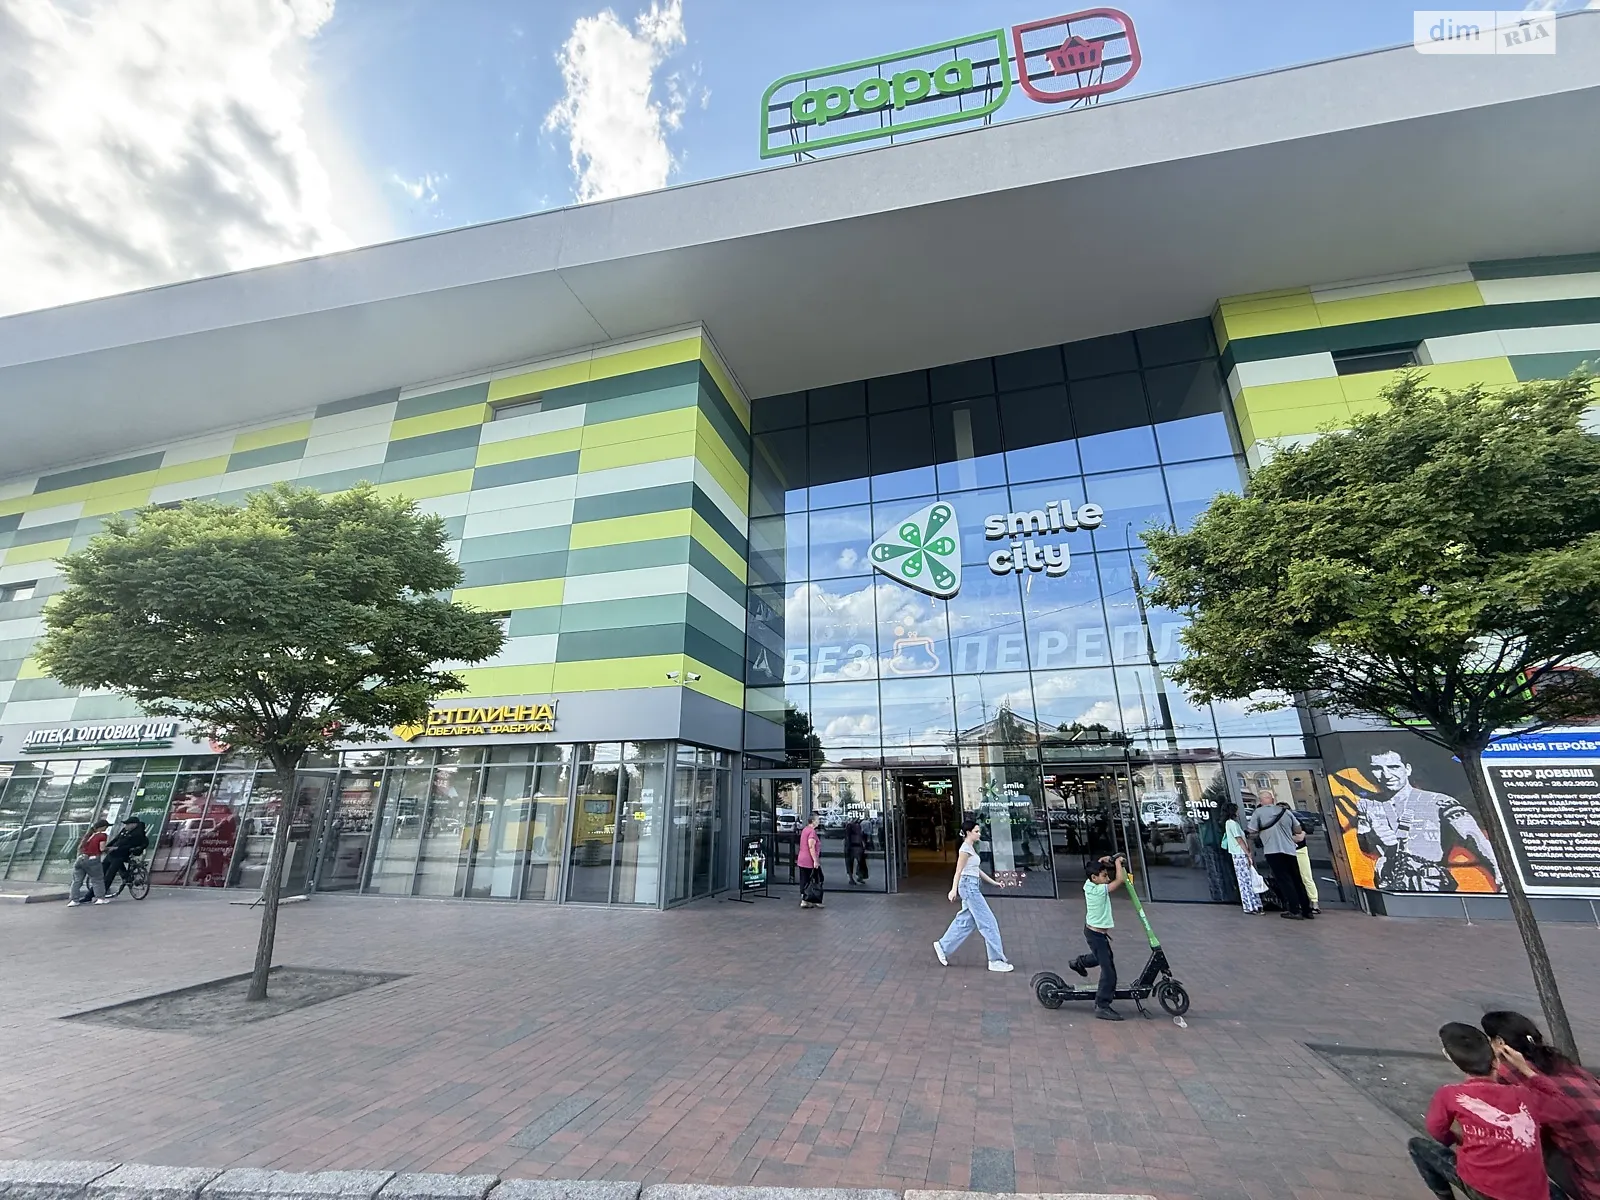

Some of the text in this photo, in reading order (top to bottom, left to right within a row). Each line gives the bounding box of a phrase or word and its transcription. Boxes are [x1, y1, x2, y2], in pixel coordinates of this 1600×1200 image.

[792, 58, 973, 127] фора
[984, 499, 1104, 541] smile
[988, 541, 1072, 578] city
[784, 643, 872, 683] БЕЗ
[428, 703, 553, 725] СТОЛИЧНА
[23, 722, 175, 745] АПТЕКА ОПТОВИХ ЦІН
[425, 722, 553, 737] ЮВЕЛІРНА ФАБРИКА
[1500, 769, 1532, 778] ІГОР
[1003, 789, 1019, 798] city
[847, 801, 872, 811] smile
[1185, 798, 1218, 809] smile
[847, 810, 865, 820] city
[1186, 809, 1209, 820] city
